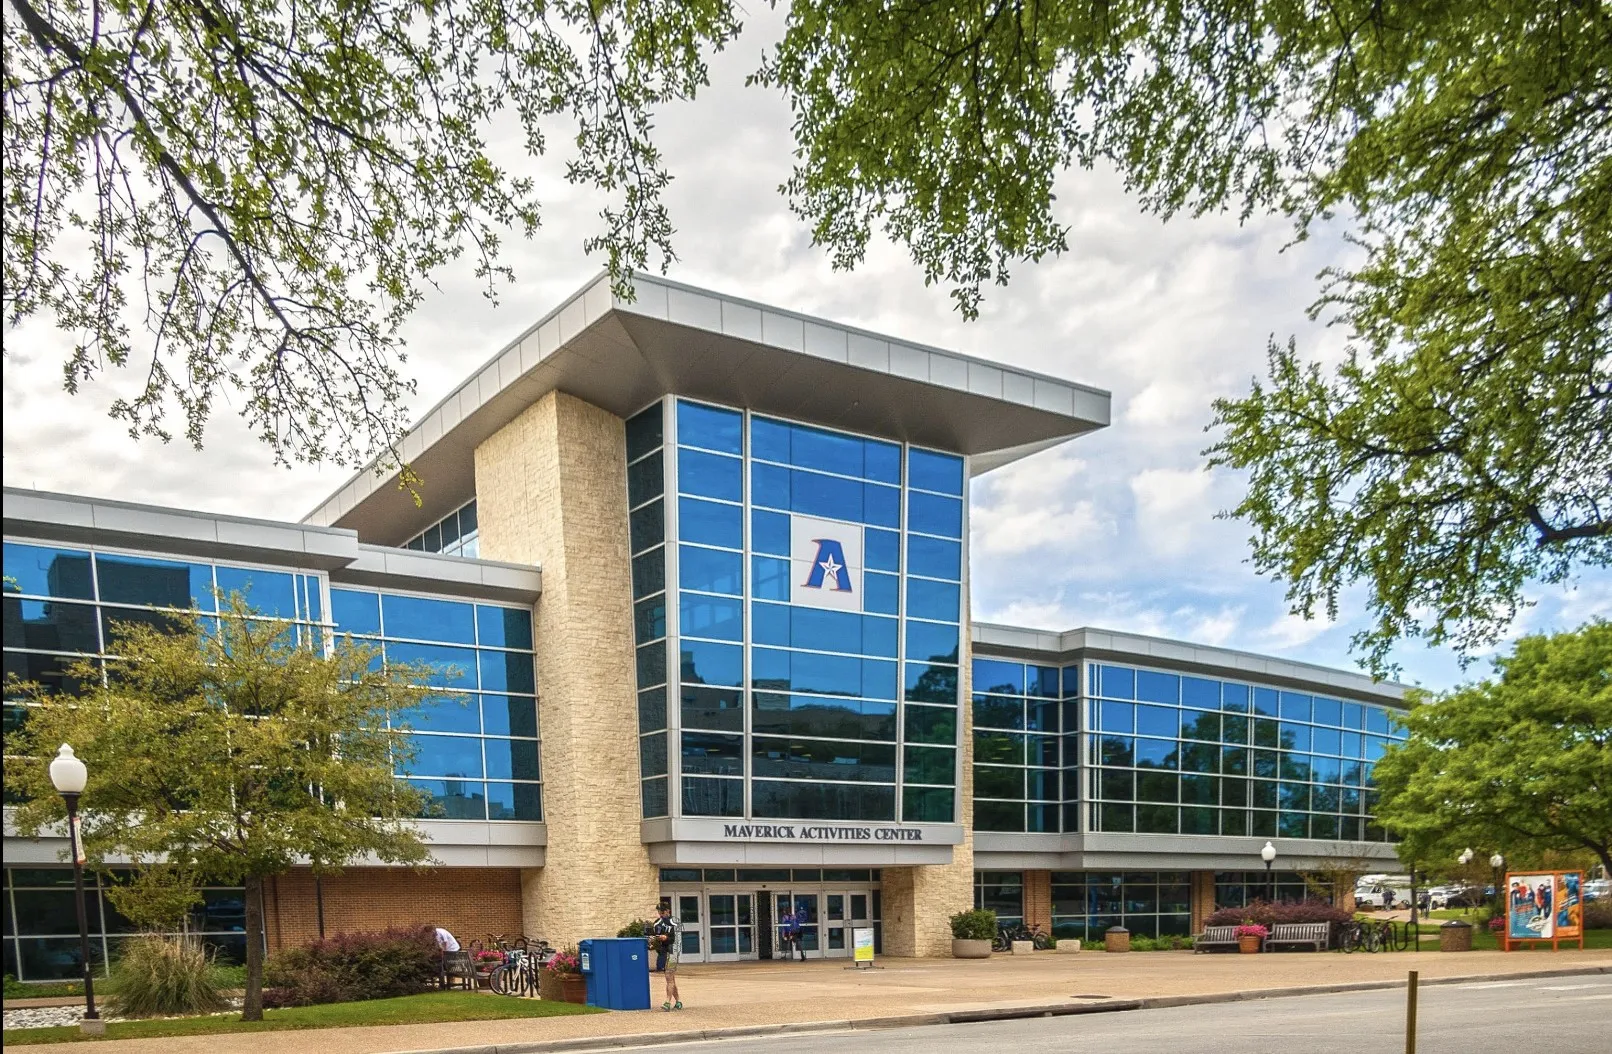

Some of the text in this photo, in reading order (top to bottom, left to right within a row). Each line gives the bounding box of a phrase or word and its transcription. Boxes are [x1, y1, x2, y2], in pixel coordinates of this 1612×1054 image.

[800, 538, 853, 593] A
[724, 824, 922, 841] MAVERICK ACTIVITIES CENTER
